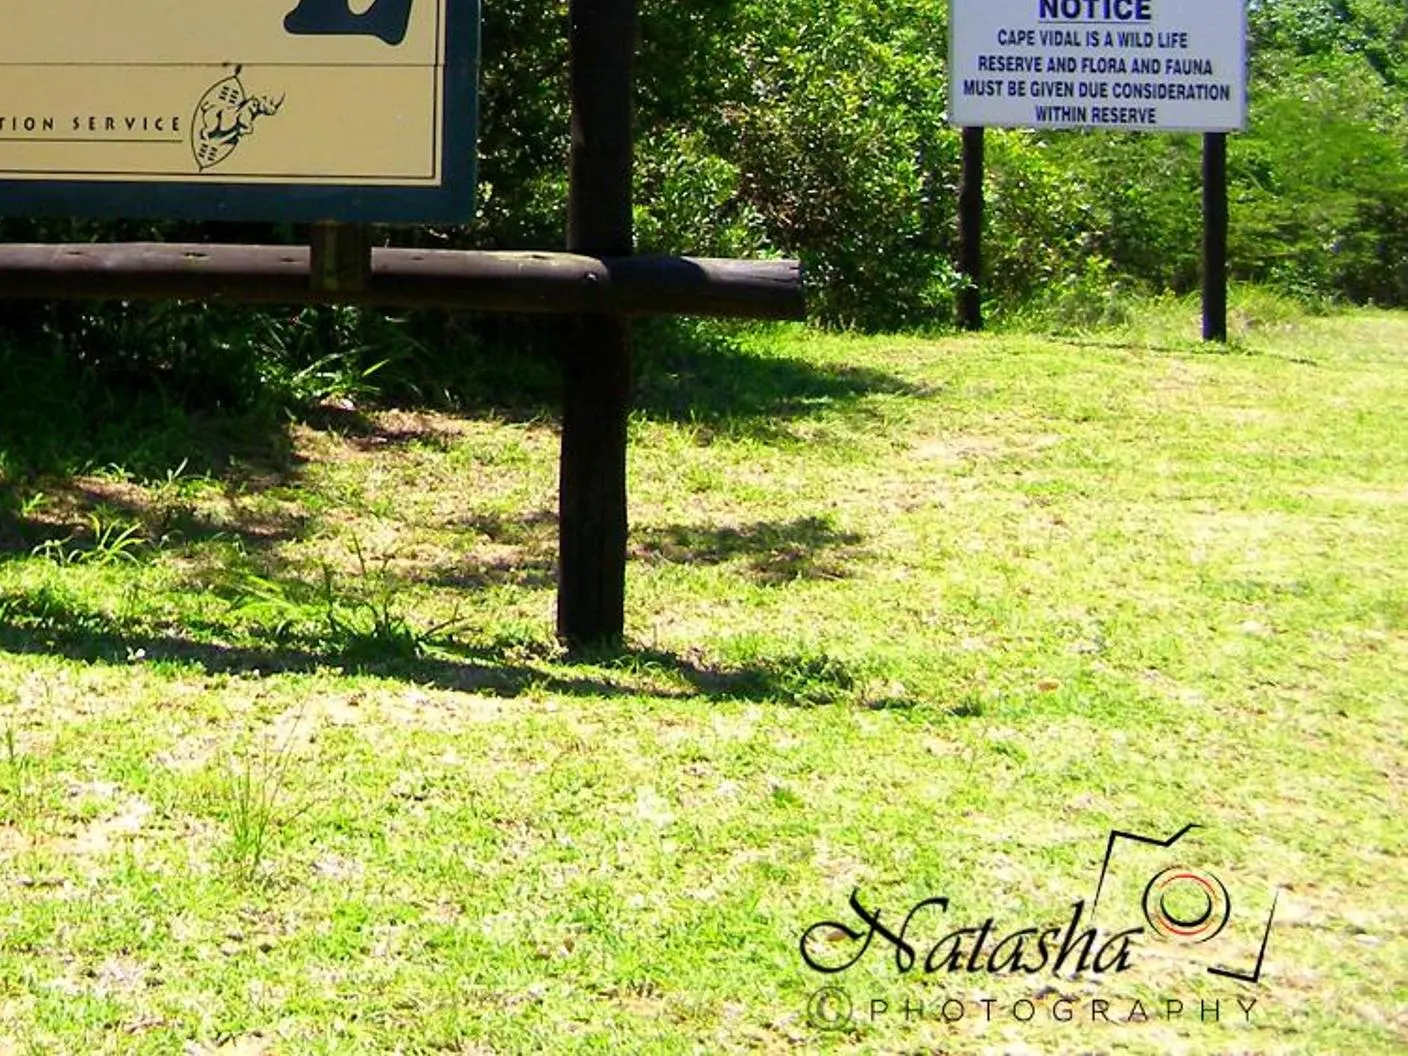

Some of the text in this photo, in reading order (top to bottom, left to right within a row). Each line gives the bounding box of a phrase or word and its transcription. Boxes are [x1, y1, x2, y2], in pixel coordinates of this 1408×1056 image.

[997, 28, 1189, 49] CAPE VIDAL IS A WILD LIFE
[978, 55, 1213, 76] RESERVE AND FLORA AND FAUNA
[963, 79, 1230, 101] MUST BE GIVEN DUE CONSIDERATION
[72, 116, 180, 132] SERVICE
[1035, 105, 1157, 124] WITHIN RESERVE
